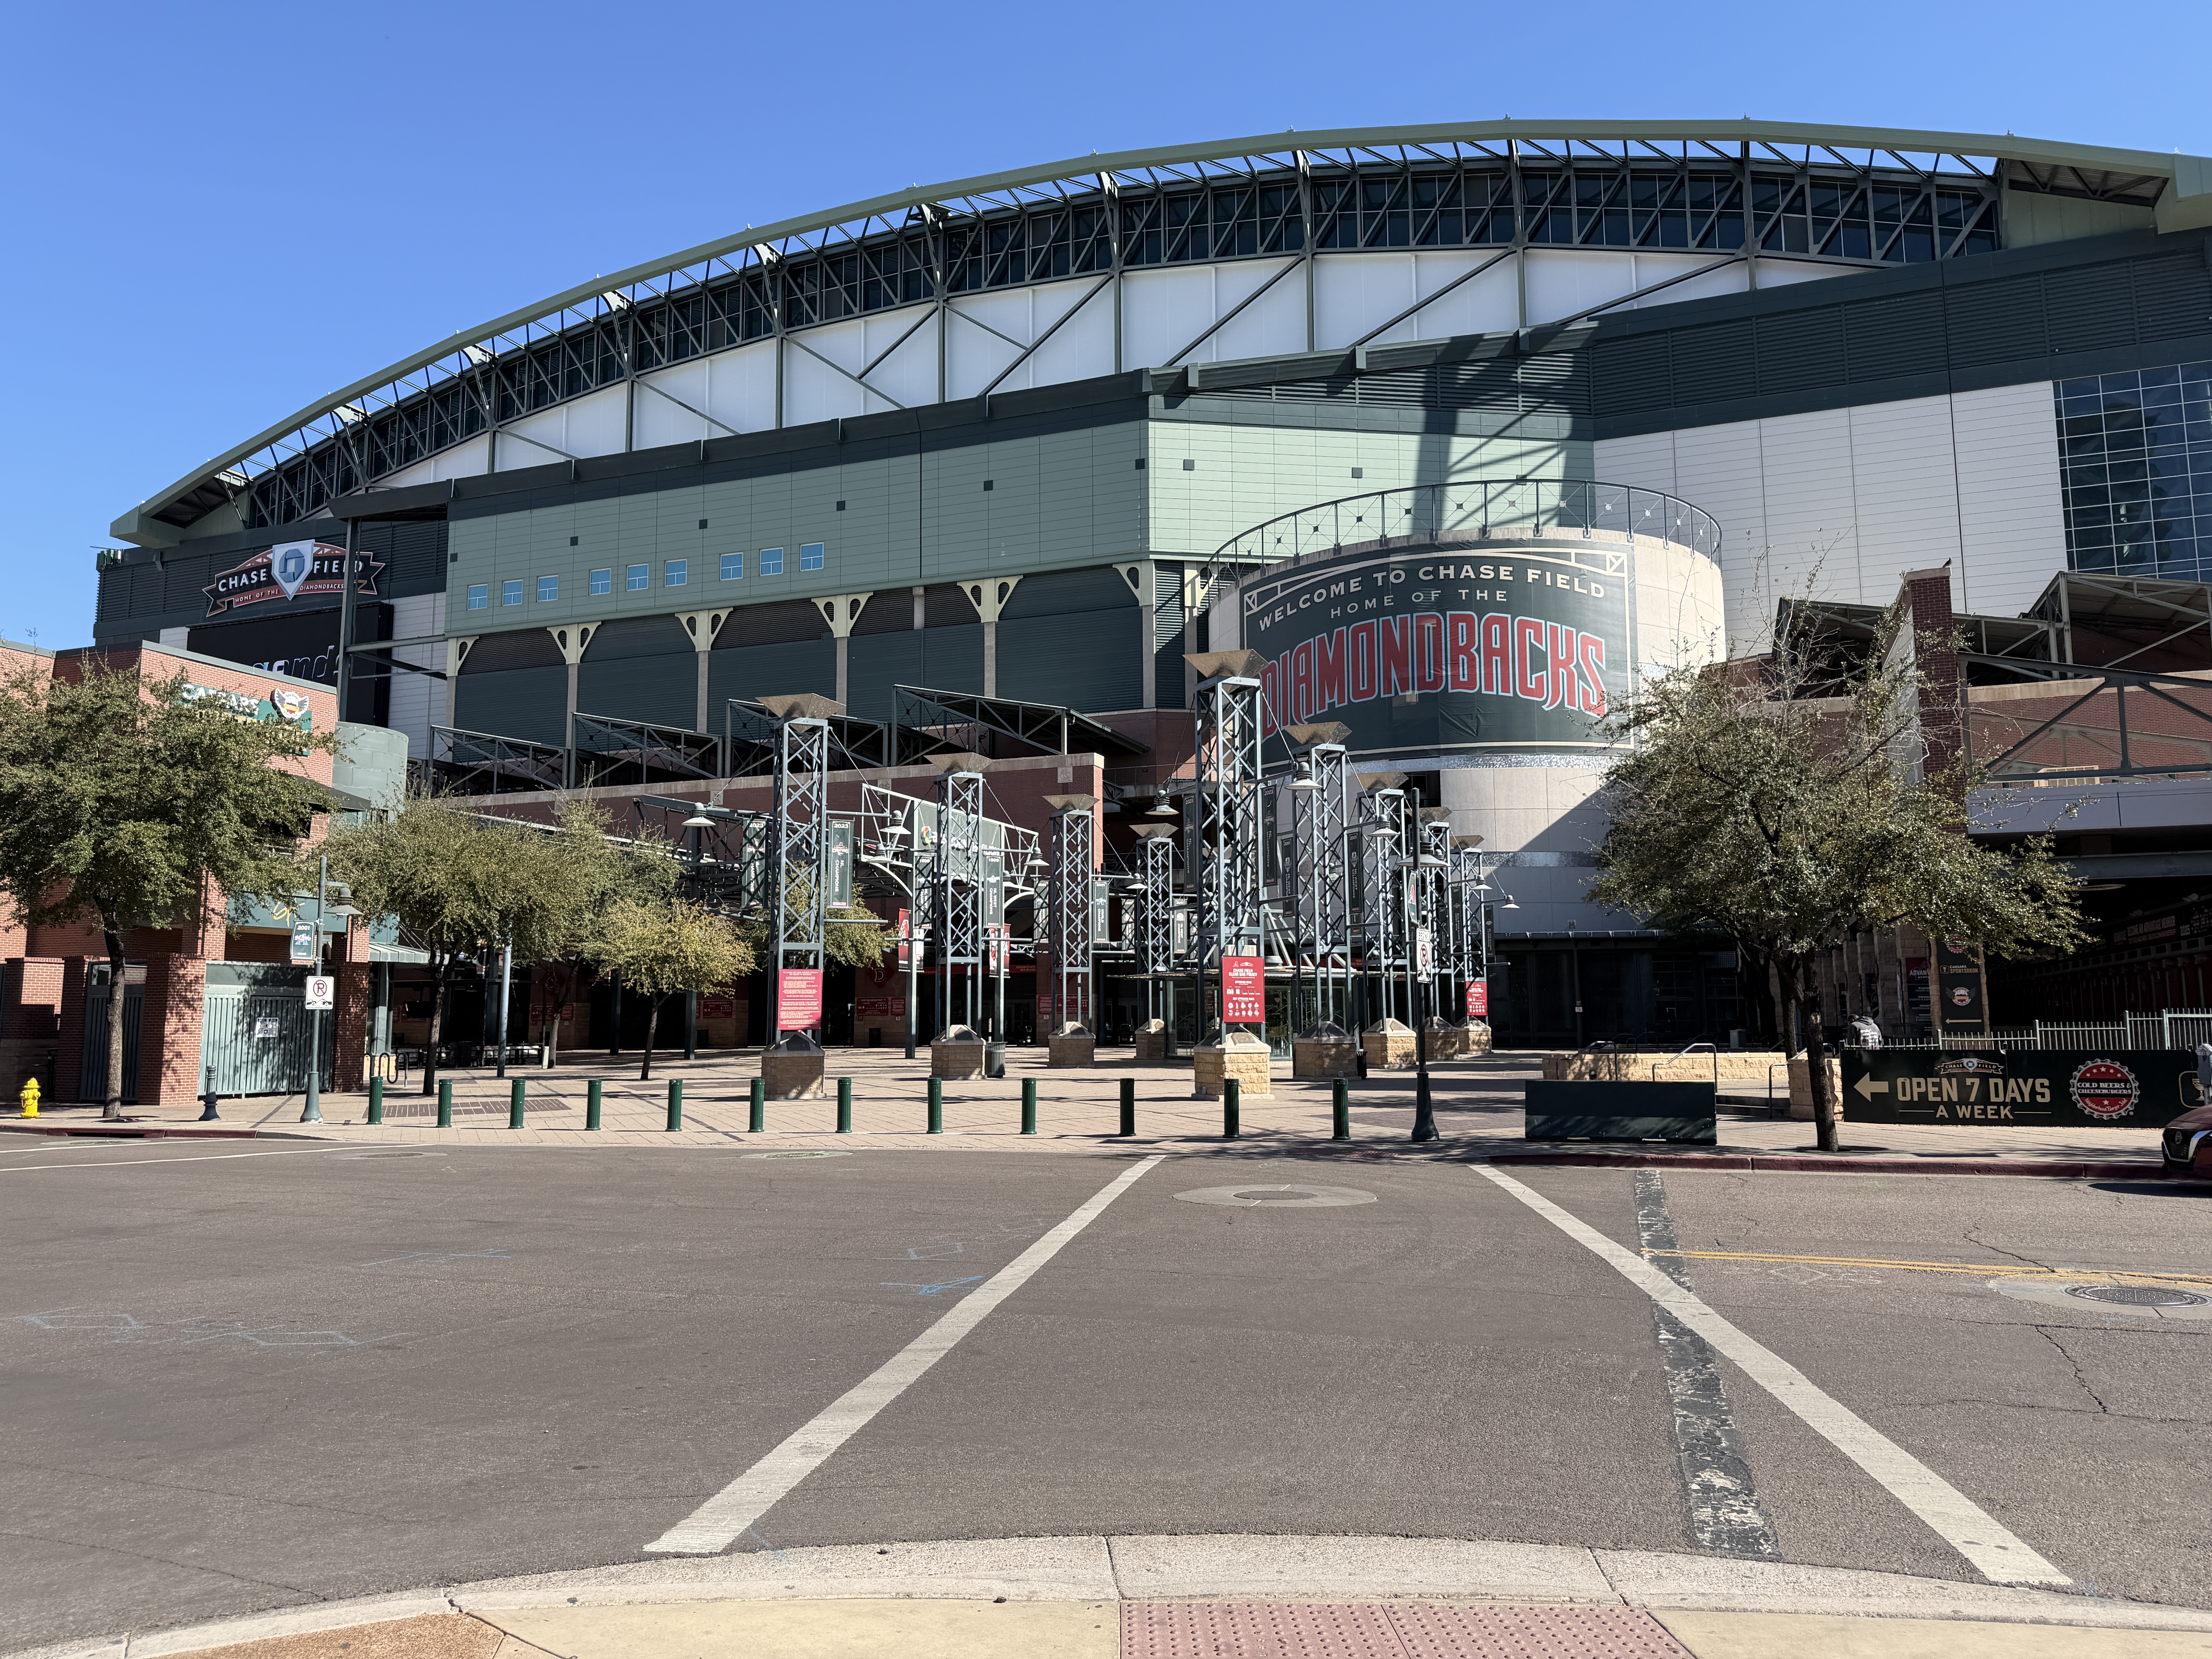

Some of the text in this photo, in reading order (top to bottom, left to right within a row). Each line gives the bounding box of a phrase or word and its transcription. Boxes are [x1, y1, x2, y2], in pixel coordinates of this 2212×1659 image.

[218, 560, 363, 592] CHASE FIED
[235, 594, 252, 603] HOME
[1259, 565, 1605, 632] WELCOME TO CHASE FIELD
[1330, 589, 1508, 618] HOME OF THE
[1260, 611, 1607, 741] DIAMONDBACKS
[874, 969, 886, 982] D
[1897, 1077, 2050, 1102] OPEN 7 DAYS
[1936, 1105, 2013, 1119] A WEEK
